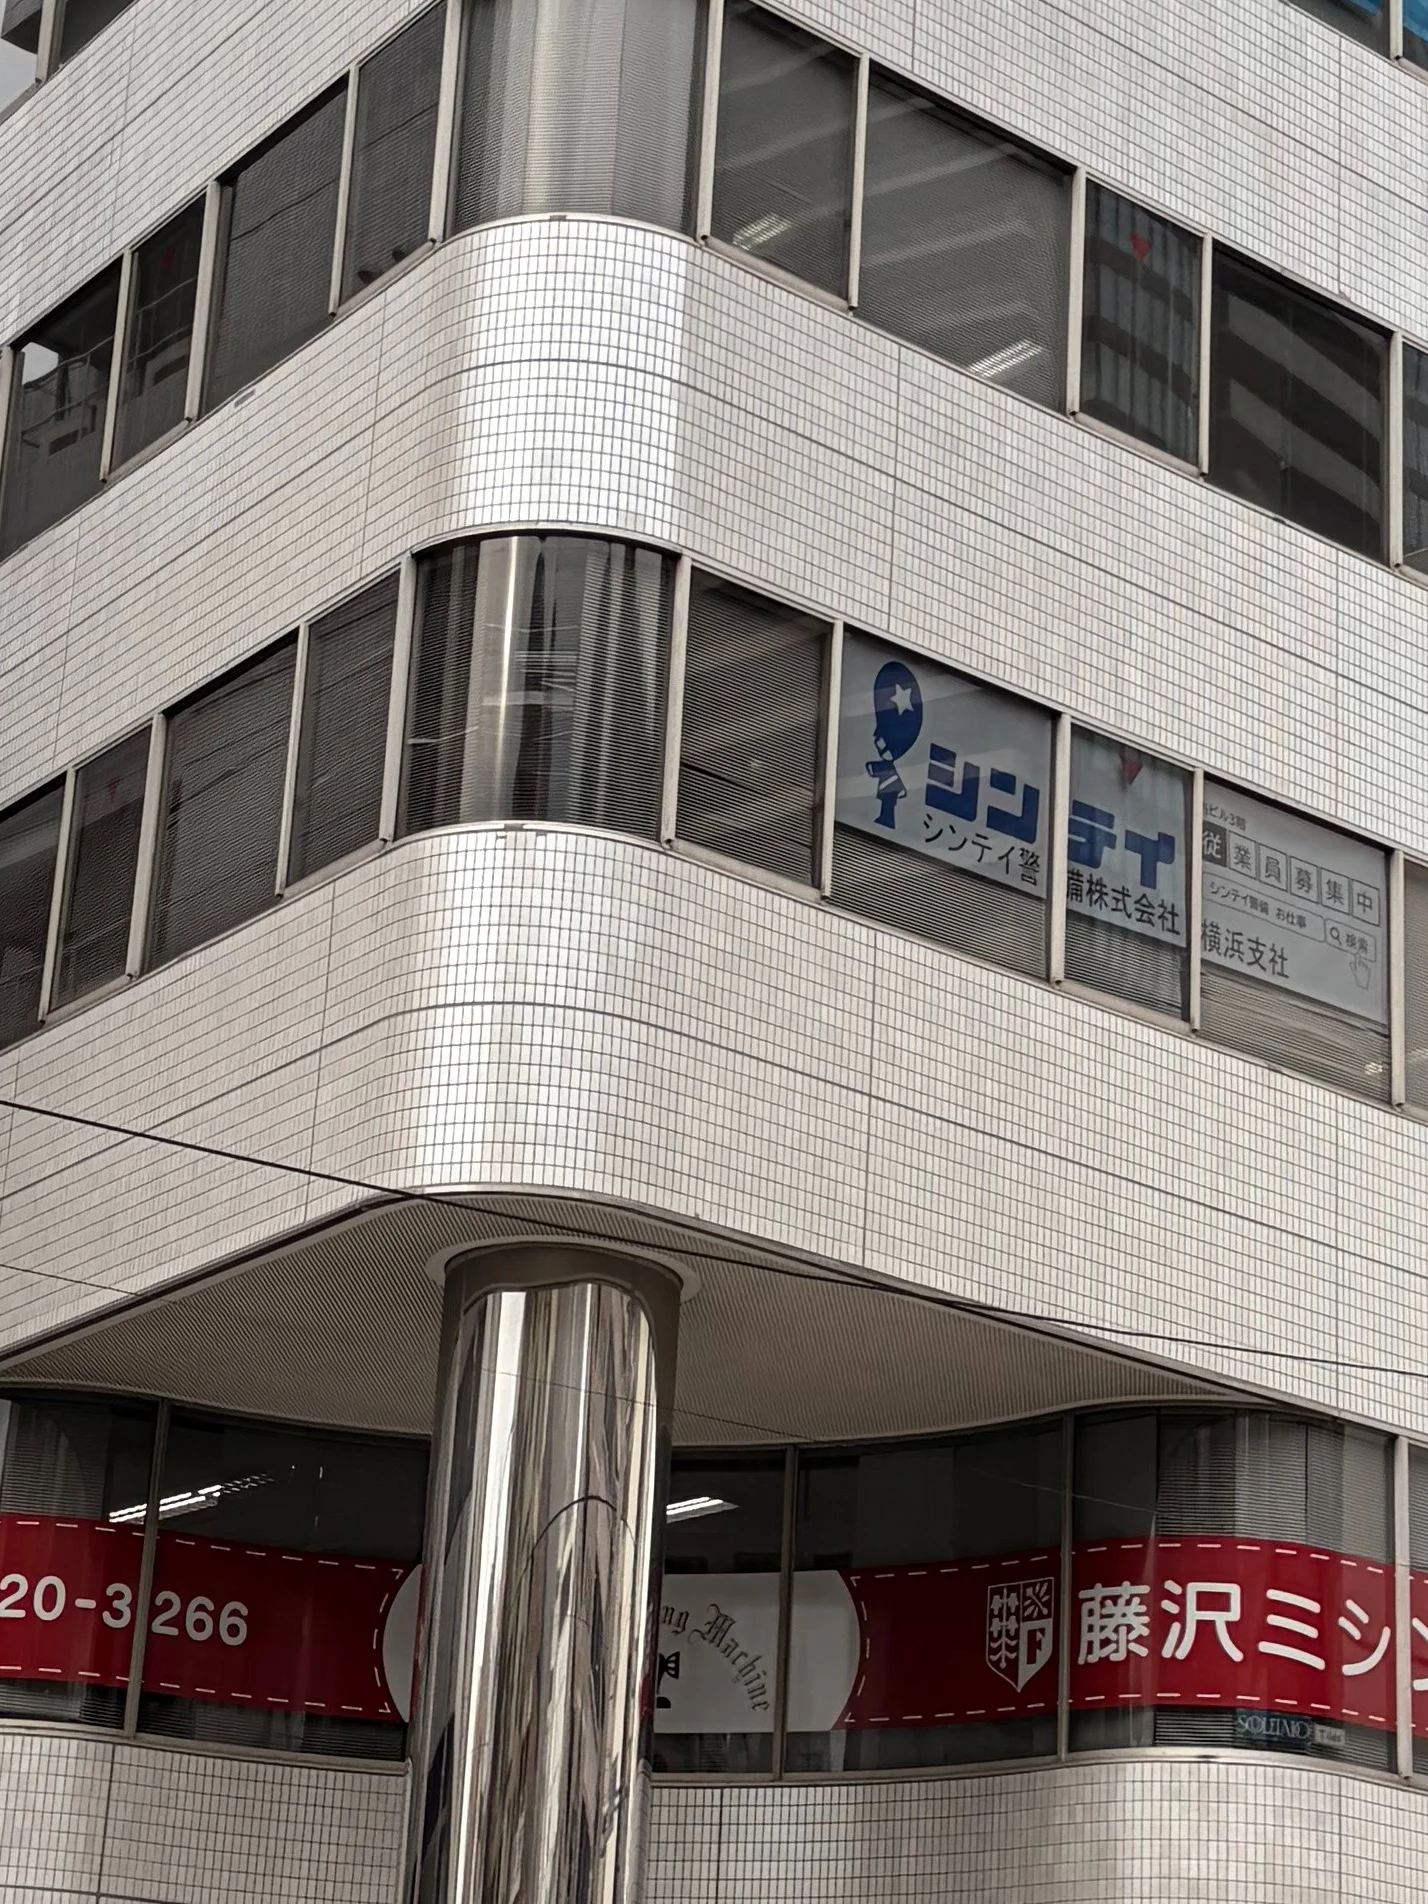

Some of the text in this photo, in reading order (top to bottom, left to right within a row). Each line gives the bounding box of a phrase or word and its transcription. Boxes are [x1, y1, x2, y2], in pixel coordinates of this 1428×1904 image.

[924, 742, 1176, 889] シンテイ
[921, 811, 1182, 938] シンテイ警備株式会社
[1202, 829, 1373, 914] 従業員募集中
[1201, 917, 1290, 980] 横浜支社
[688, 1602, 770, 1712] Machine
